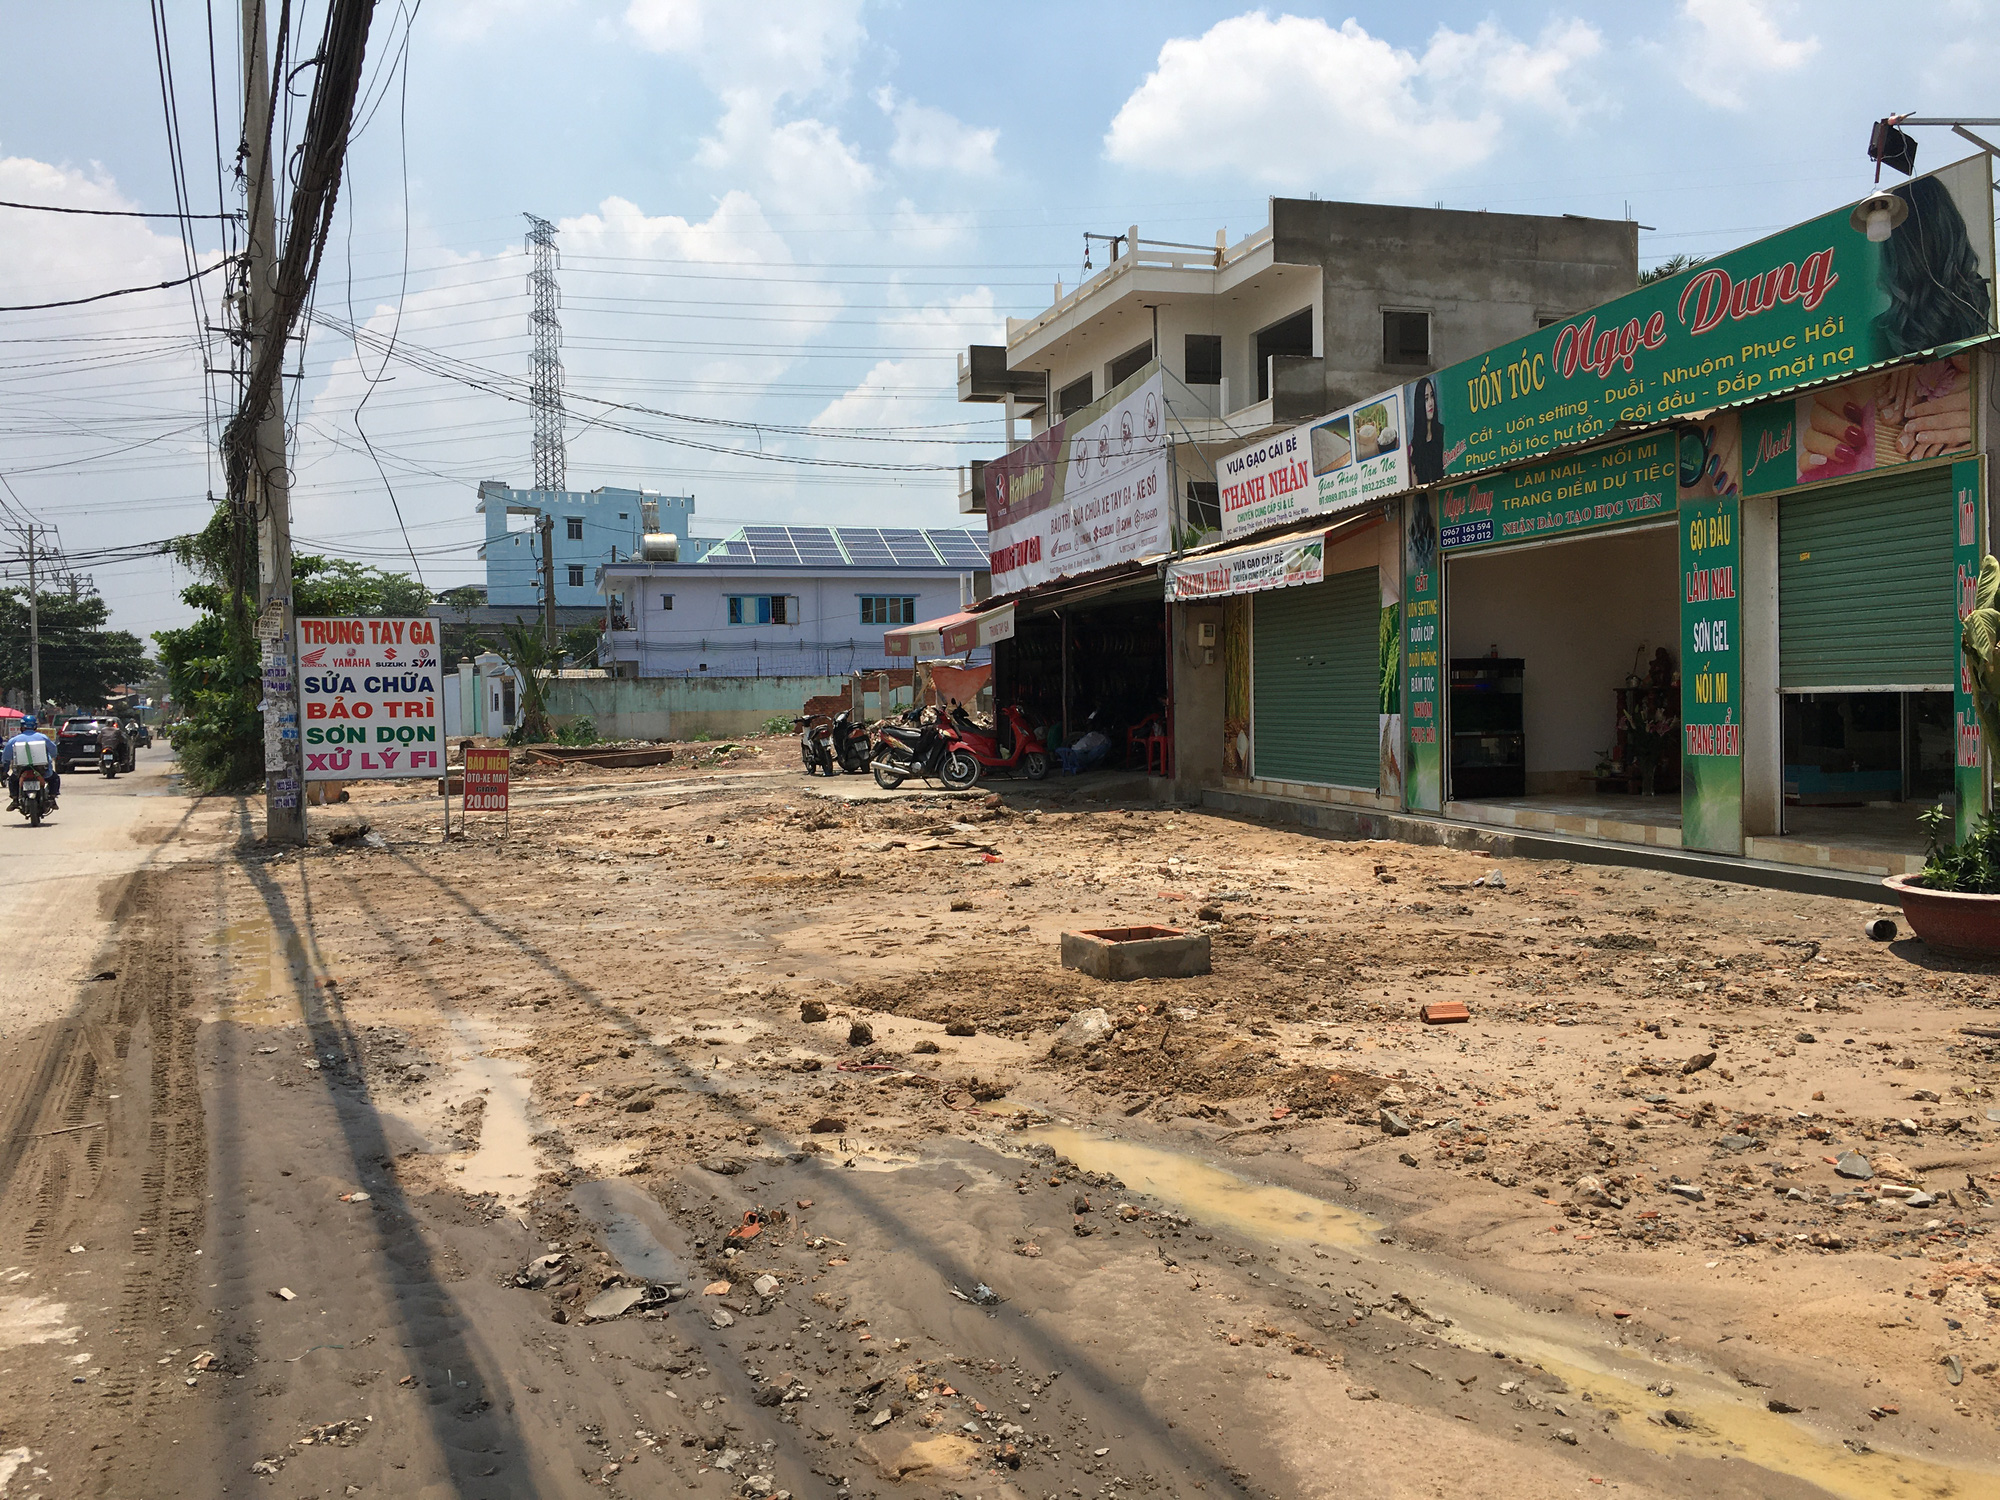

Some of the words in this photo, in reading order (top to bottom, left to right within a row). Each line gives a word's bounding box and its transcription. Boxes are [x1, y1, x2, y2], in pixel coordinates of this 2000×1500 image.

[1467, 355, 1502, 413] UỐN
[1507, 347, 1546, 400] TÓC
[1552, 311, 1668, 380] Ngọc
[1678, 246, 1840, 337] Dung
[1469, 426, 1493, 445] Cắt
[1506, 414, 1534, 434] Uốn
[1538, 400, 1588, 424] setting
[1605, 378, 1644, 404] Duỗi
[1663, 354, 1734, 386] Nhuộm
[1741, 335, 1796, 363] Phục
[1805, 315, 1844, 343] Hồi
[1465, 449, 1497, 467] Phục
[1501, 439, 1522, 457] hồi
[1525, 434, 1549, 450] tóc
[1554, 425, 1573, 442] hư
[1577, 415, 1603, 435] tổn
[1620, 402, 1652, 421] Gội
[1657, 390, 1695, 412] đầu
[1717, 370, 1762, 396] Đắp
[1769, 354, 1815, 382] mặt
[1822, 345, 1854, 367] nạ
[1226, 458, 1245, 476] VỰA
[1246, 449, 1266, 468] GẠO
[1268, 440, 1283, 459] CÁI
[1746, 421, 1792, 476] Nail
[1515, 471, 1546, 489] LÀM
[1550, 462, 1586, 480] NAIL
[1602, 445, 1632, 468] NỐI
[1638, 443, 1657, 460] MI
[1101, 495, 1110, 516] XE
[1110, 489, 1122, 511] TAY
[1123, 485, 1131, 506] GA
[1136, 479, 1145, 500] XE
[1147, 466, 1157, 496] SỐ
[1222, 476, 1266, 512] THANH
[1268, 457, 1308, 498] NHÀN
[1318, 478, 1334, 496] Giao
[1337, 471, 1358, 486] Hàng
[1502, 490, 1552, 511] TRANG
[1557, 477, 1597, 499] ĐIỂM
[1603, 471, 1628, 490] DỰ
[1632, 462, 1675, 483] TIỆC
[1255, 504, 1267, 518] CUNG
[1283, 499, 1287, 510] &
[1443, 489, 1466, 523] Ngọc
[1468, 484, 1494, 515] Dung
[1502, 517, 1535, 536] NHẬN
[1537, 511, 1563, 529] ĐÀO
[1565, 507, 1591, 525] TẠO
[1594, 501, 1623, 519] HỌC
[1626, 492, 1662, 512] VIÊN
[1099, 523, 1114, 538] SUZUKI
[1442, 527, 1460, 537] 0967
[1462, 524, 1475, 534] 163
[1477, 521, 1491, 531] 594
[1442, 536, 1460, 546] 0901
[1461, 534, 1475, 543] 329
[1476, 531, 1491, 540] 012
[1690, 511, 1707, 556] GỘI
[1709, 502, 1731, 548] ĐẦU
[1176, 572, 1204, 596] THANH
[1205, 562, 1231, 593] NHÀN
[1415, 568, 1428, 592] CẮT
[1686, 562, 1709, 603] LÀM
[1711, 566, 1735, 600] NAIL
[1418, 599, 1437, 616] SETTING
[301, 620, 365, 645] TRUNG
[368, 620, 406, 645] TAY
[409, 621, 436, 645] GA
[1423, 621, 1434, 641] CÚP
[1693, 617, 1710, 653] SƠN
[1712, 620, 1729, 652] GEL
[332, 658, 371, 668] YAMAHA
[411, 659, 436, 668] SYM
[304, 670, 357, 694] SỬA
[364, 671, 435, 693] CHỮA
[1424, 672, 1435, 692] TÓC
[1695, 660, 1712, 703] NỐI
[1715, 672, 1728, 703] MI
[306, 696, 373, 719] BẢO
[383, 696, 435, 719] TRÌ
[306, 724, 367, 745] SƠN
[376, 726, 436, 747] DỌN
[1686, 723, 1714, 756] TRANG
[1716, 706, 1739, 756] ĐIỂM
[305, 747, 353, 771] XỬ
[361, 747, 401, 770] LÝ
[410, 751, 437, 768] FI
[467, 753, 485, 770] BẢO
[466, 794, 506, 809] 20.000
